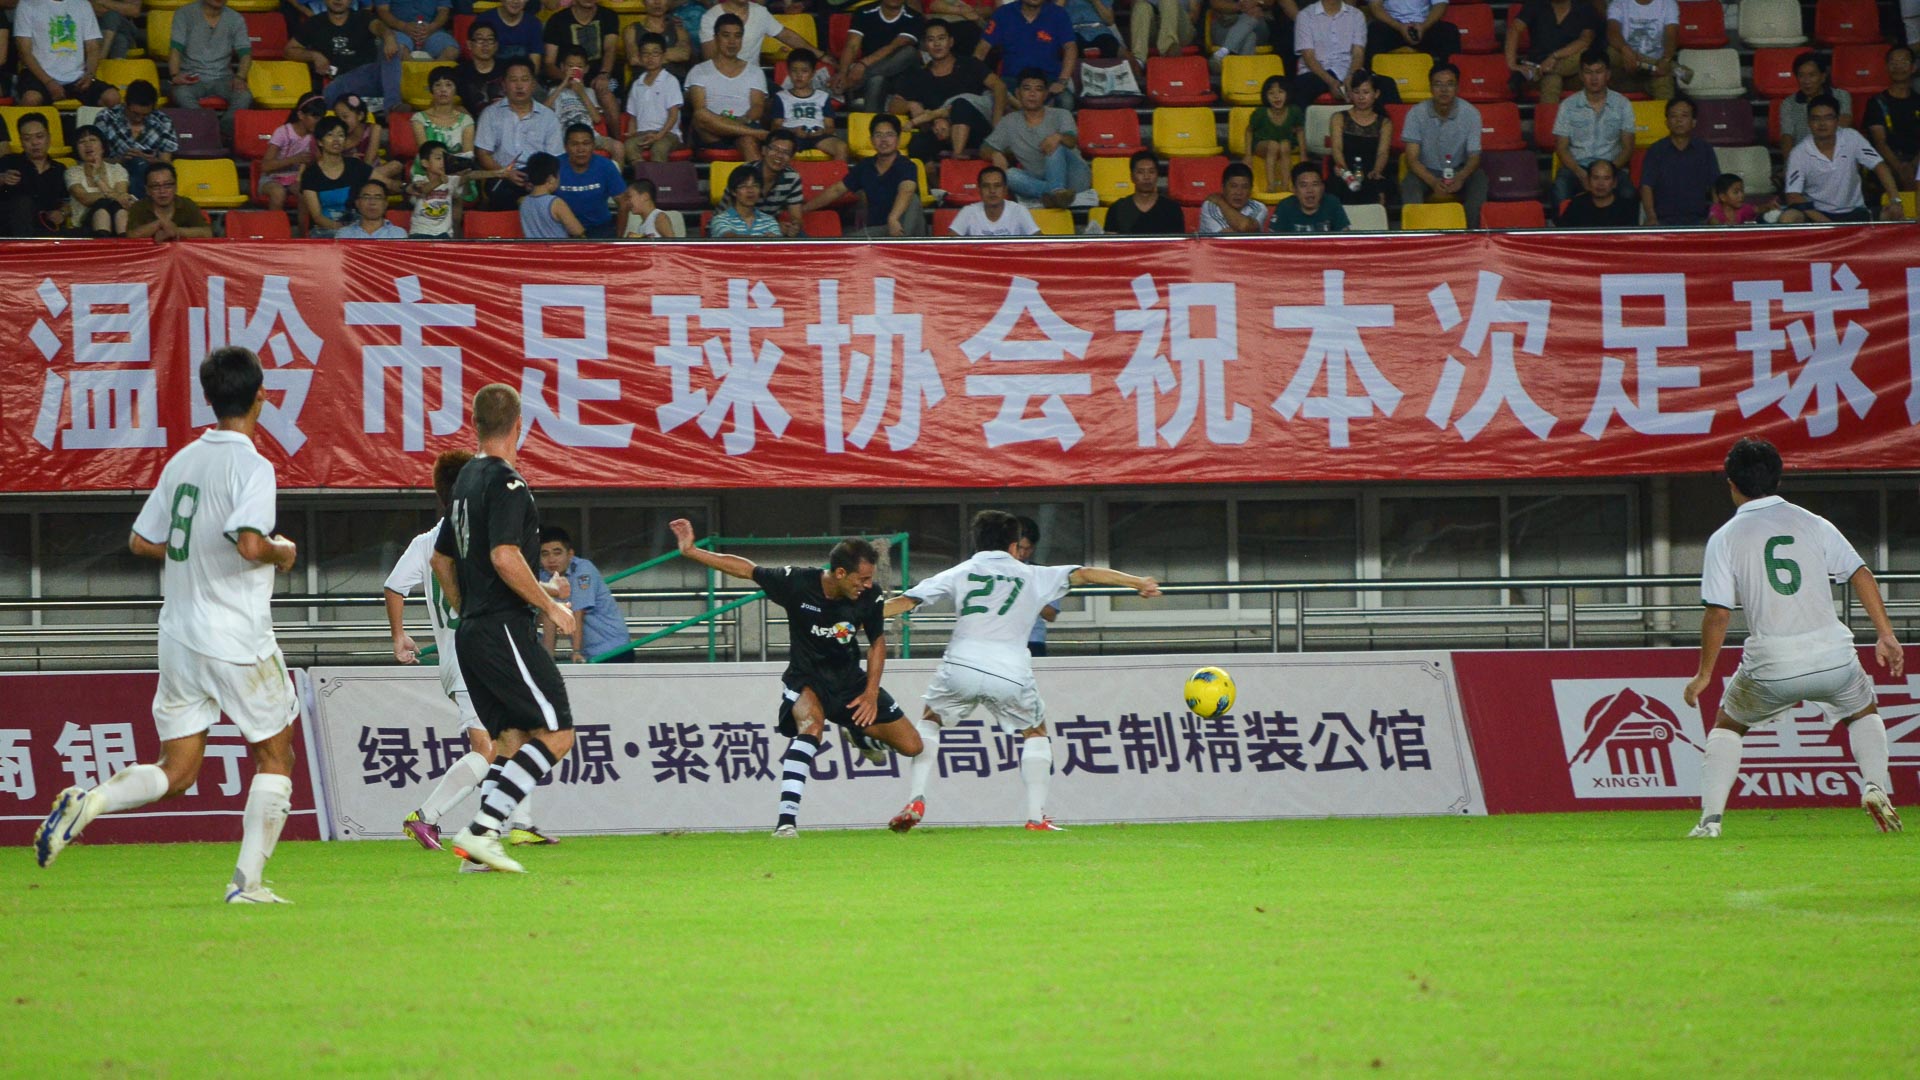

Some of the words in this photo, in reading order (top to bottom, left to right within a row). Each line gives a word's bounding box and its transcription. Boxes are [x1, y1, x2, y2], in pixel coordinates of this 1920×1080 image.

[28, 262, 1920, 456] 温岭市足球协会祝本次足球
[167, 482, 200, 562] 8
[961, 573, 1025, 616] 27
[1764, 535, 1802, 596] 6
[1592, 776, 1659, 788] XINGYI
